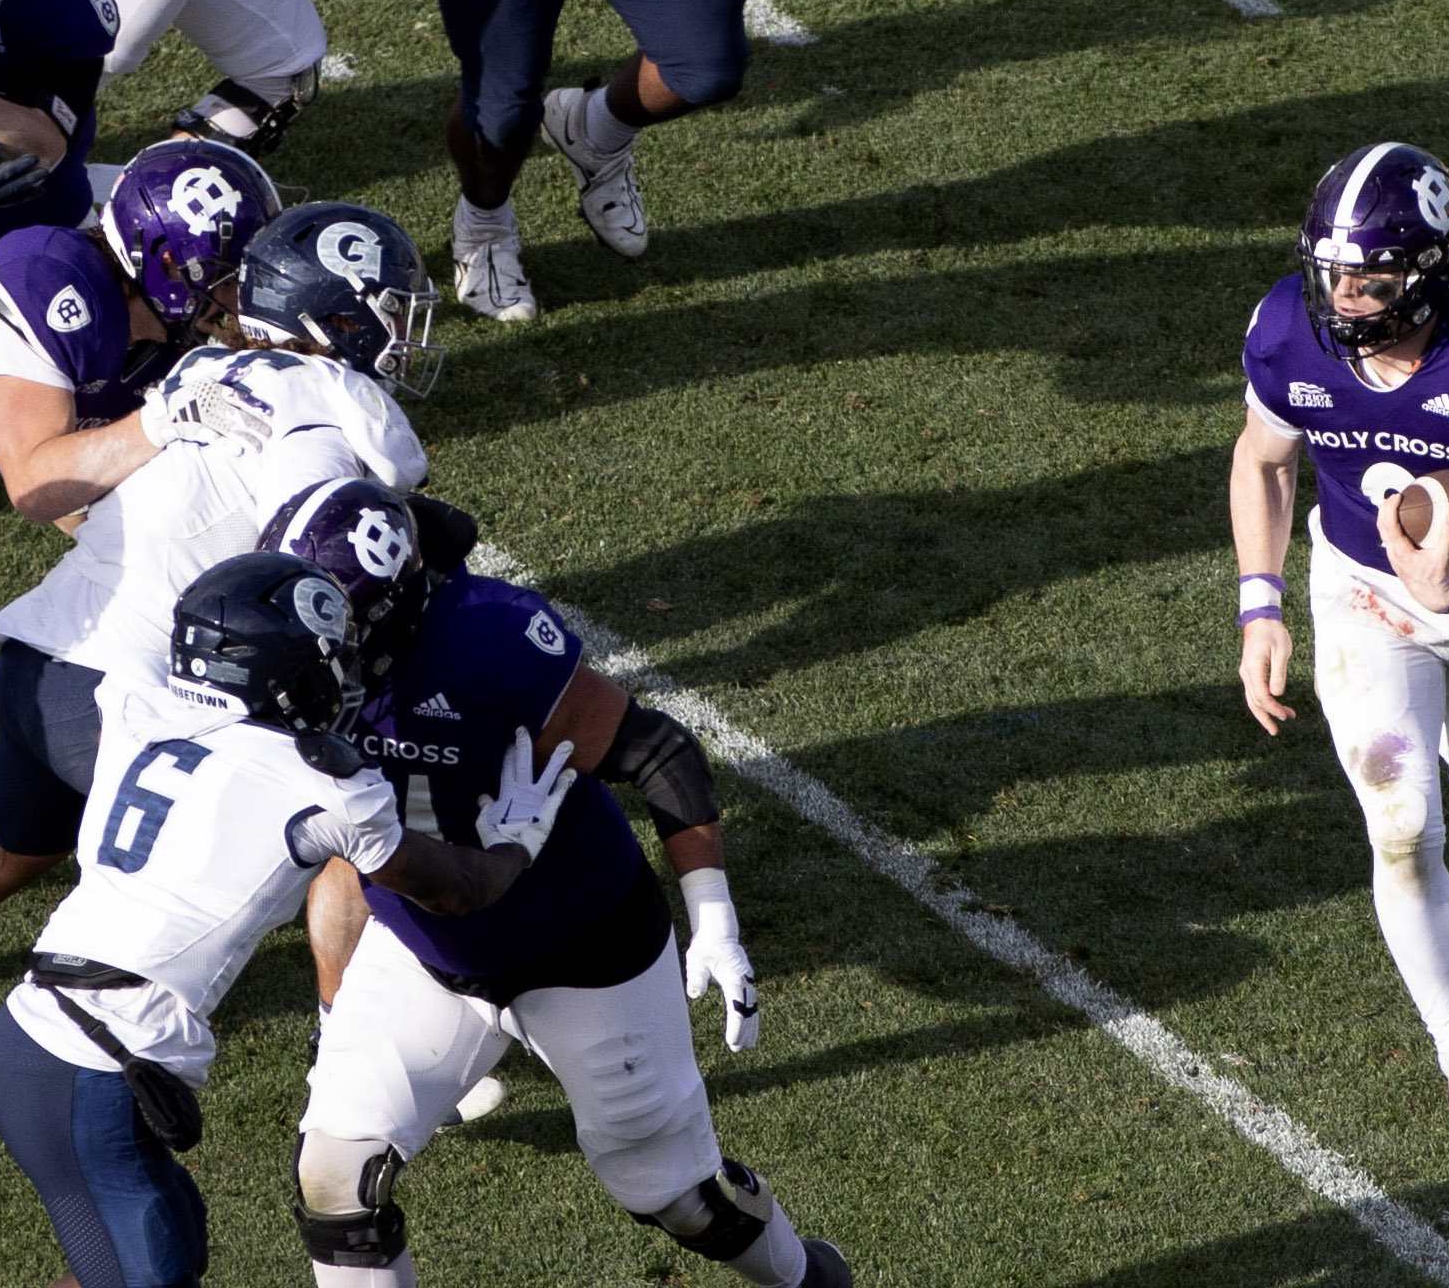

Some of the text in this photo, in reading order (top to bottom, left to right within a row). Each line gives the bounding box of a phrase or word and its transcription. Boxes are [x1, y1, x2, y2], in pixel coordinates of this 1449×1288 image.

[317, 221, 384, 282] G
[1306, 429, 1369, 449] HOLY
[413, 707, 461, 720] adidas
[363, 735, 460, 765] CROSS
[97, 739, 213, 874] 6
